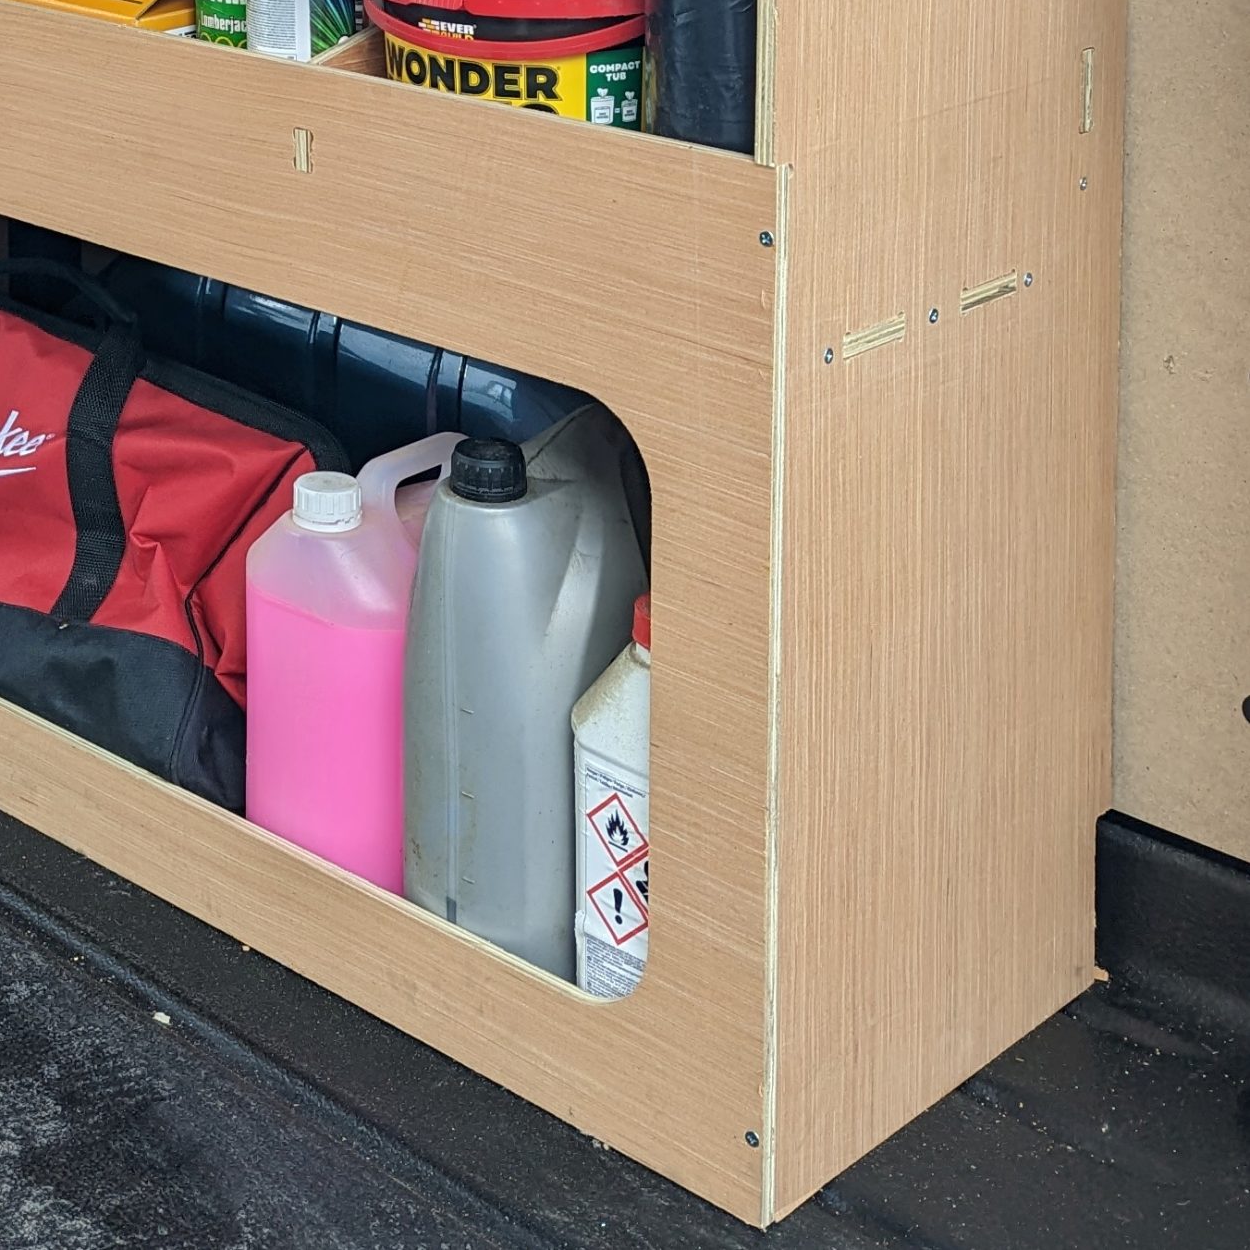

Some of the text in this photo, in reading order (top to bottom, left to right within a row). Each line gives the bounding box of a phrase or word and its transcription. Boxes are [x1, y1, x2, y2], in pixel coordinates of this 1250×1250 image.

[201, 9, 248, 34] Lumberjac
[440, 22, 474, 35] EVER
[386, 39, 562, 101] WONDER
[590, 60, 641, 74] COMPACT
[605, 71, 627, 82] TUB
